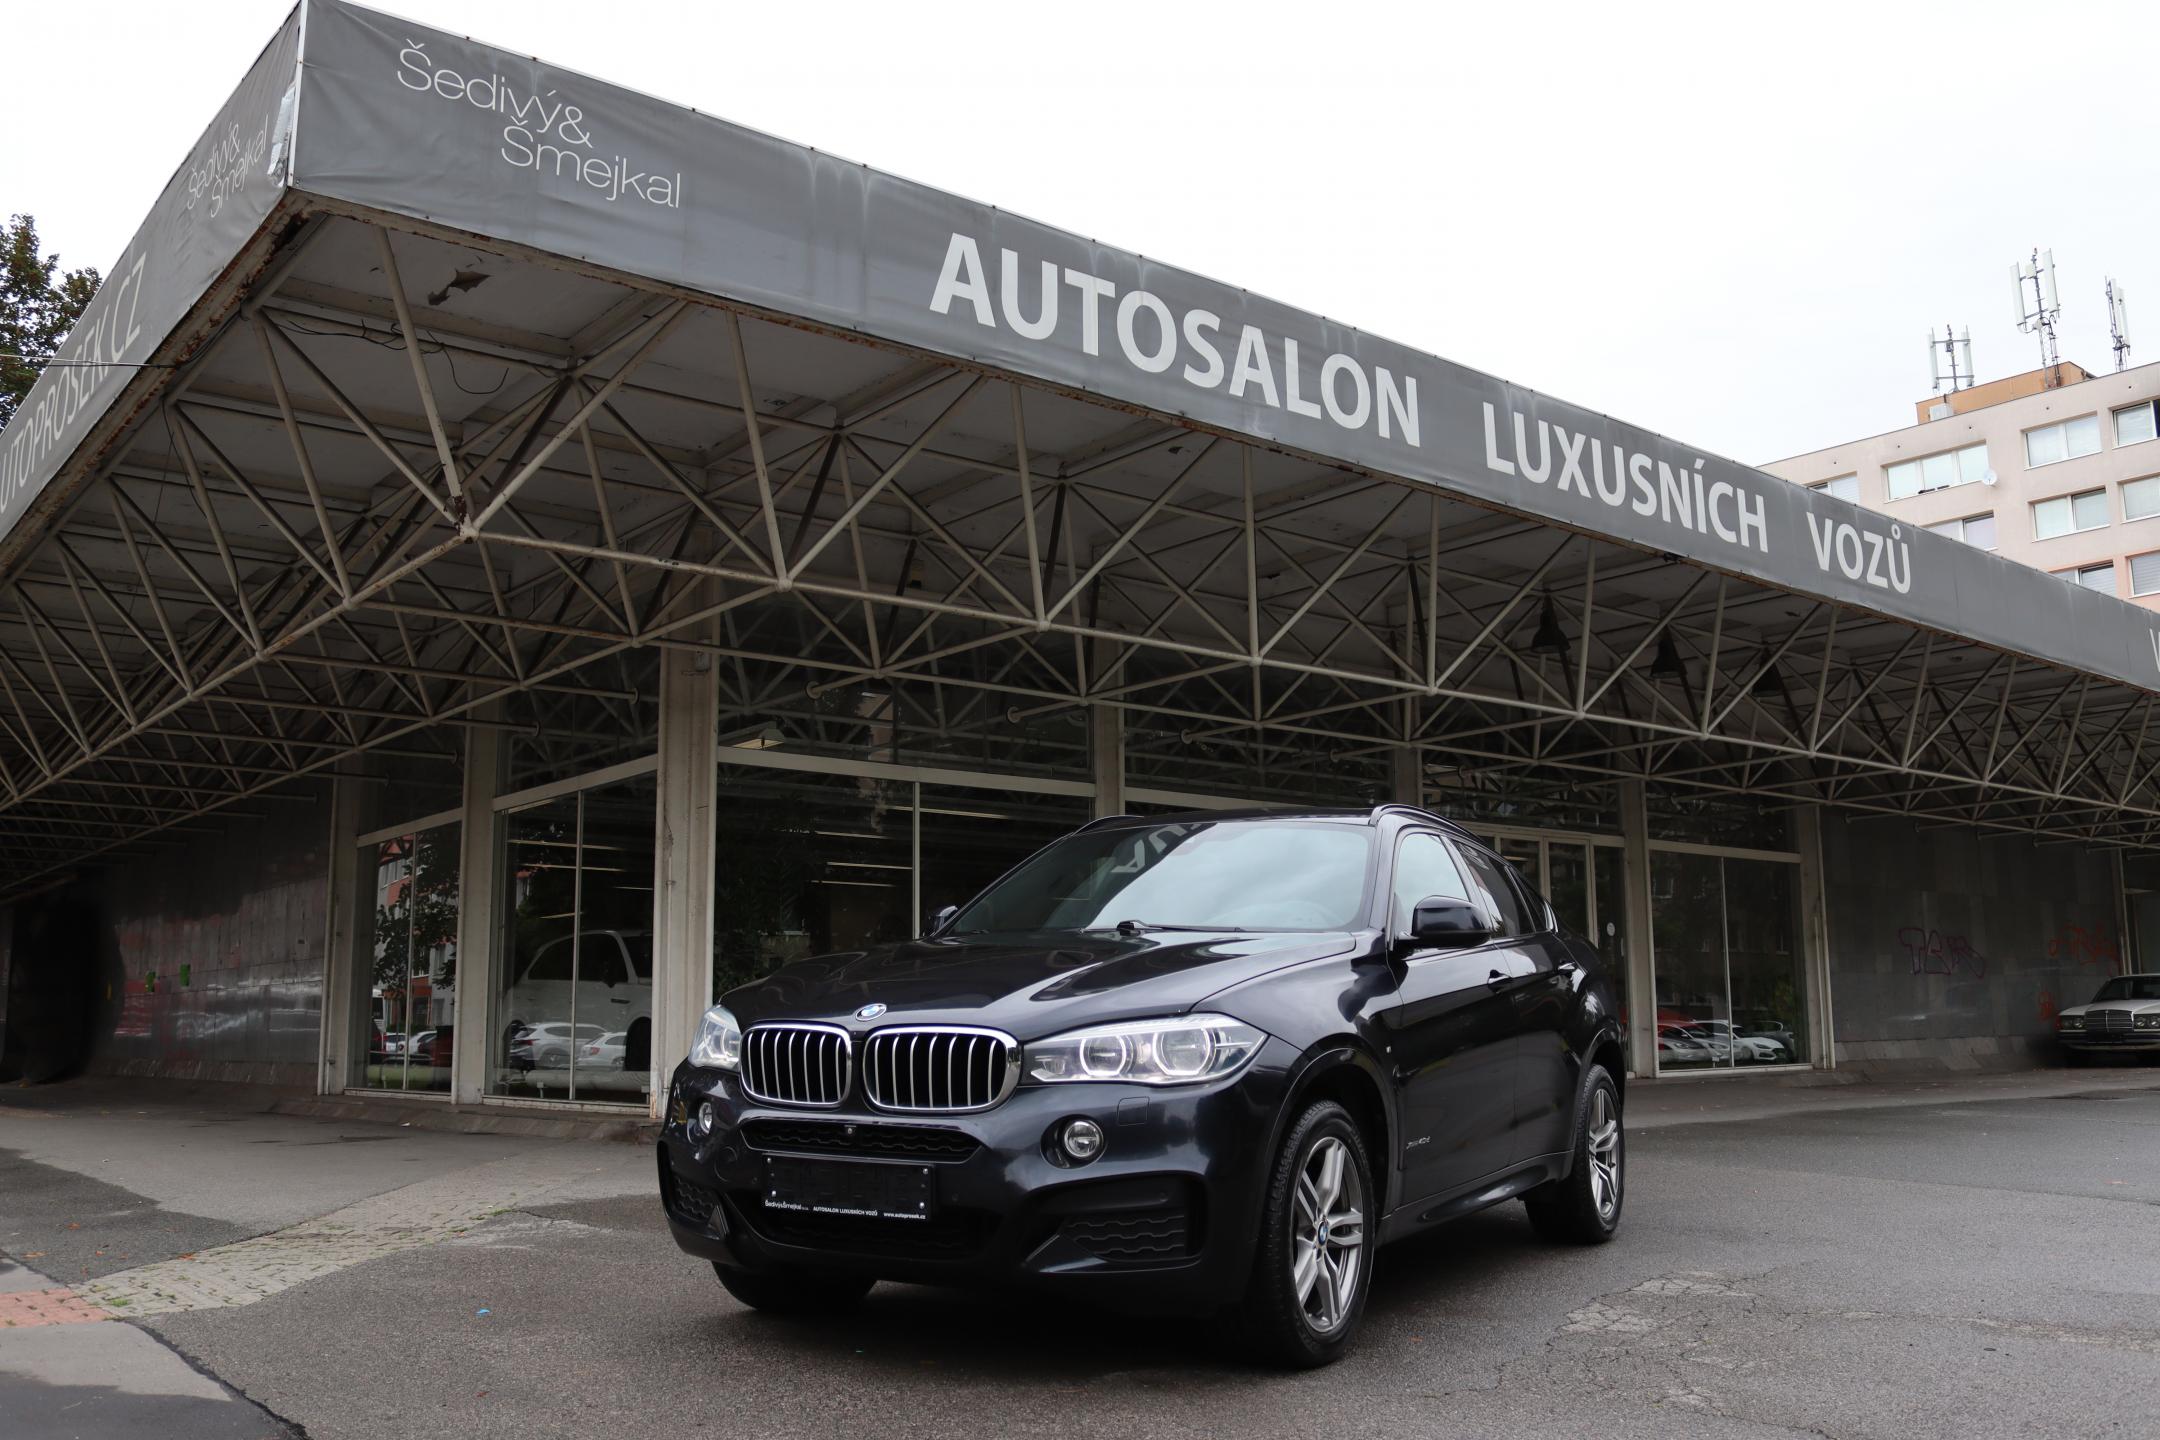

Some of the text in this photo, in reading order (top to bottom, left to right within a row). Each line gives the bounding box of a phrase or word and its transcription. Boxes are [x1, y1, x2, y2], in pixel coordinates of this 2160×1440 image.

[397, 38, 593, 149] Šedivý&
[501, 115, 681, 208] Šmejkal
[928, 232, 1912, 594] AUTOSALON LUXUSNÍCH VOZŮ
[812, 1206, 840, 1214] AUTOSALON
